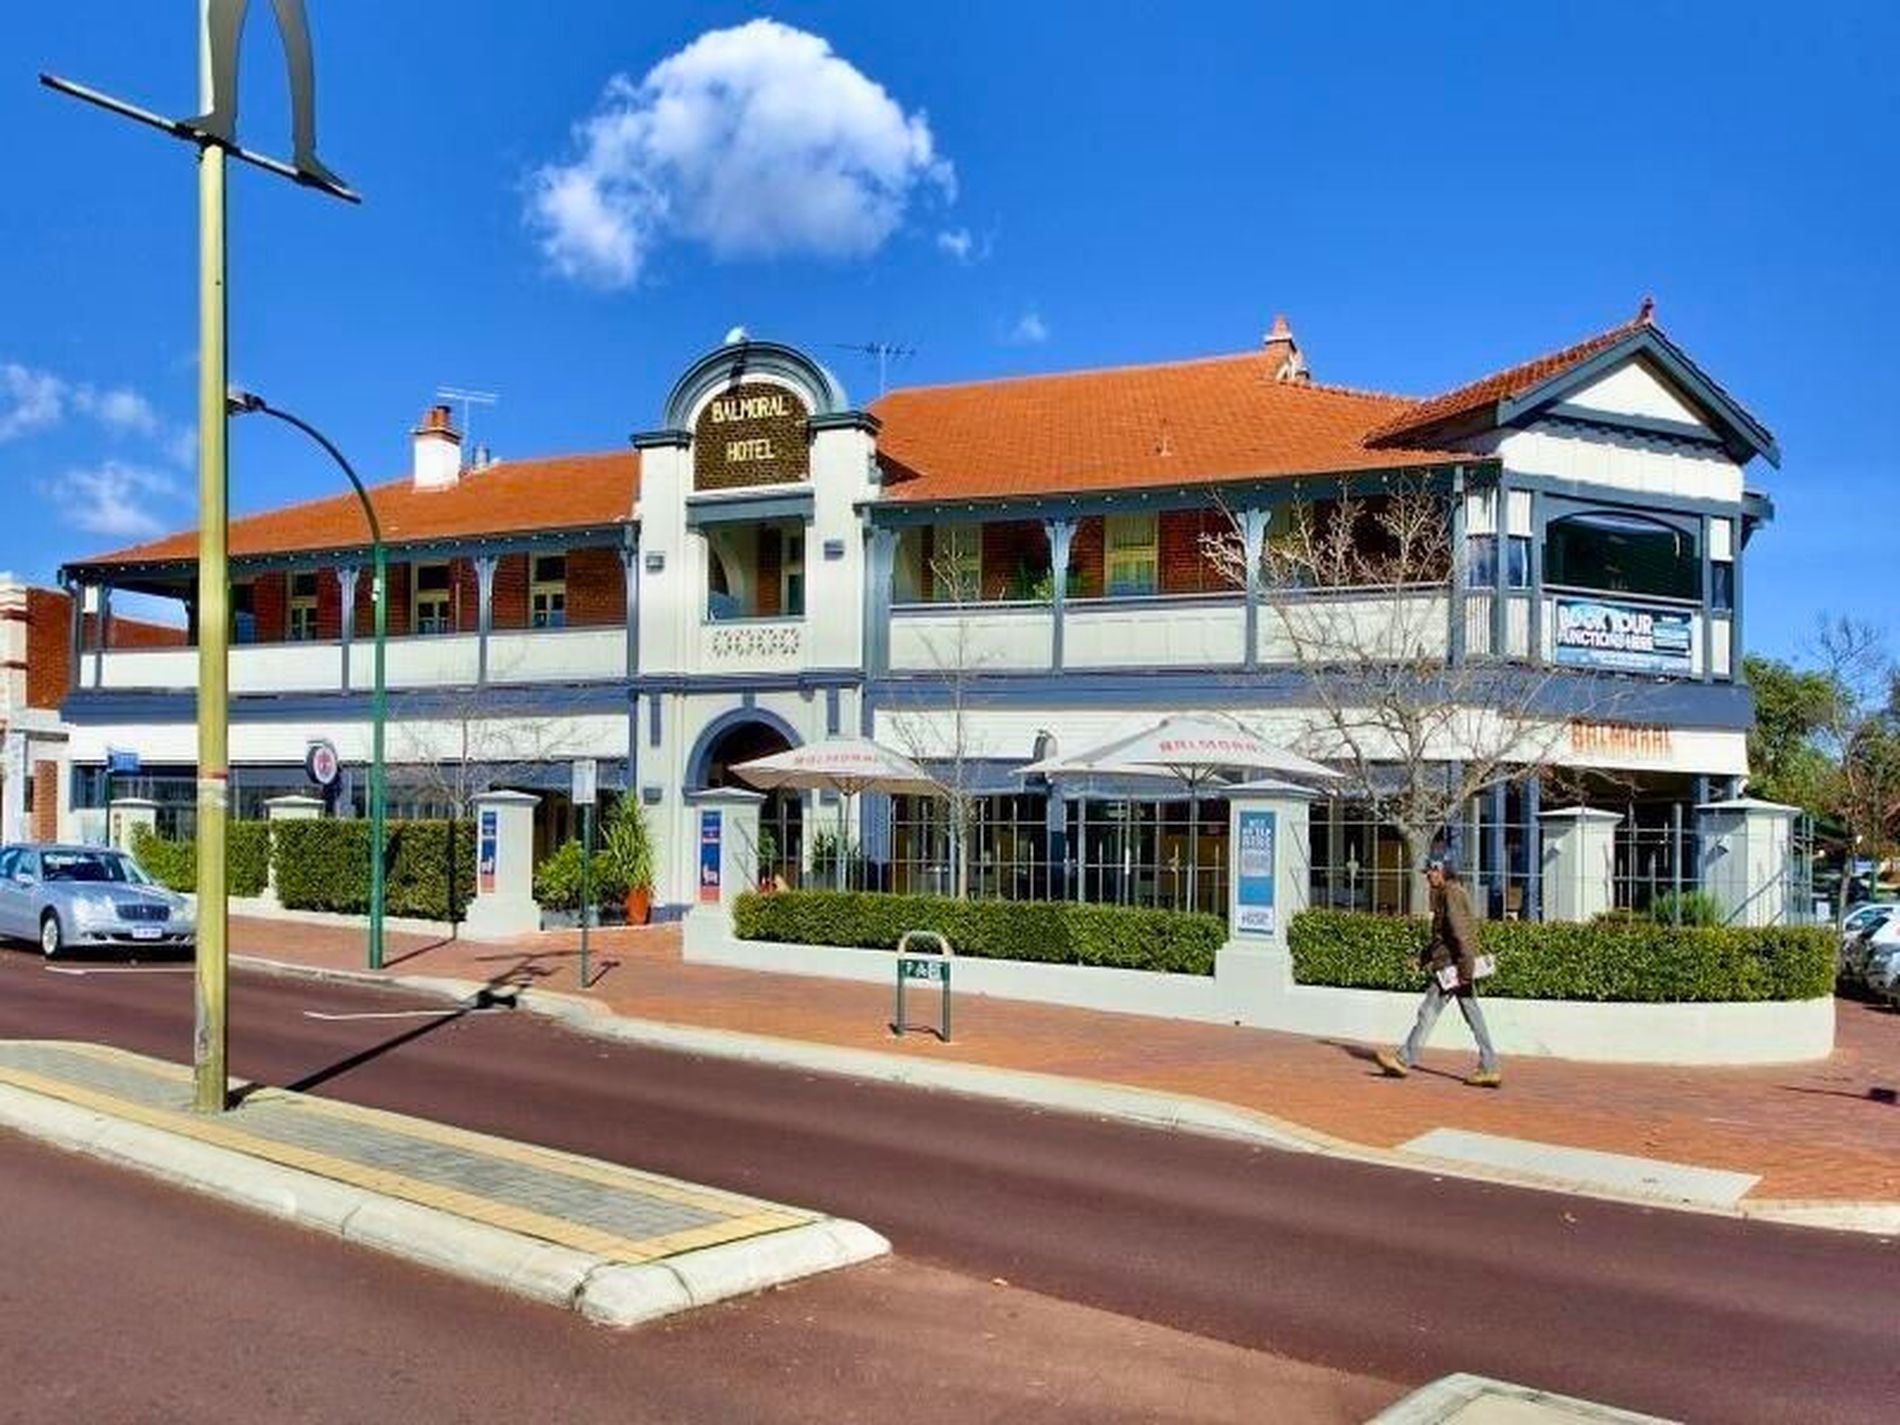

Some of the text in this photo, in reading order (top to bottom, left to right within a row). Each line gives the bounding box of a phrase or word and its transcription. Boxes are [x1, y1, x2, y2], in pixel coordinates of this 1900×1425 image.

[711, 395, 788, 423] BALMORAL
[726, 438, 775, 462] HOTEL
[1609, 612, 1653, 634] YOUR
